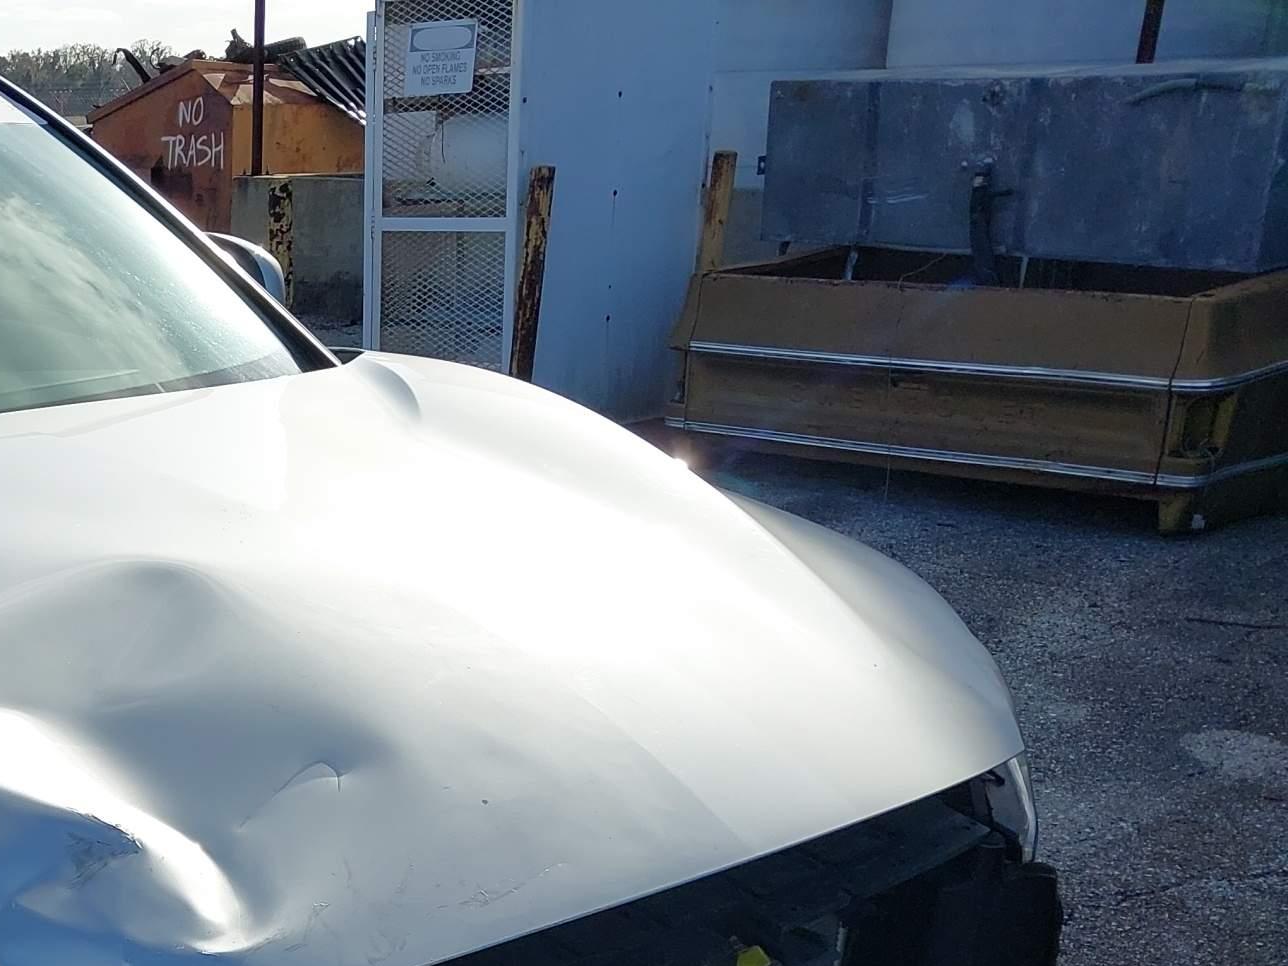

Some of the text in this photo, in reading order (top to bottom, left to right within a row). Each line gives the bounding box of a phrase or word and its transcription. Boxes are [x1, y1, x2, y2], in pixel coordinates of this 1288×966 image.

[420, 51, 461, 62] NO SMOKING
[413, 62, 467, 74] NO OPEN FLAMES
[420, 75, 457, 86] NO SPARKS
[178, 96, 204, 128] NO
[160, 131, 224, 171] TRASH
